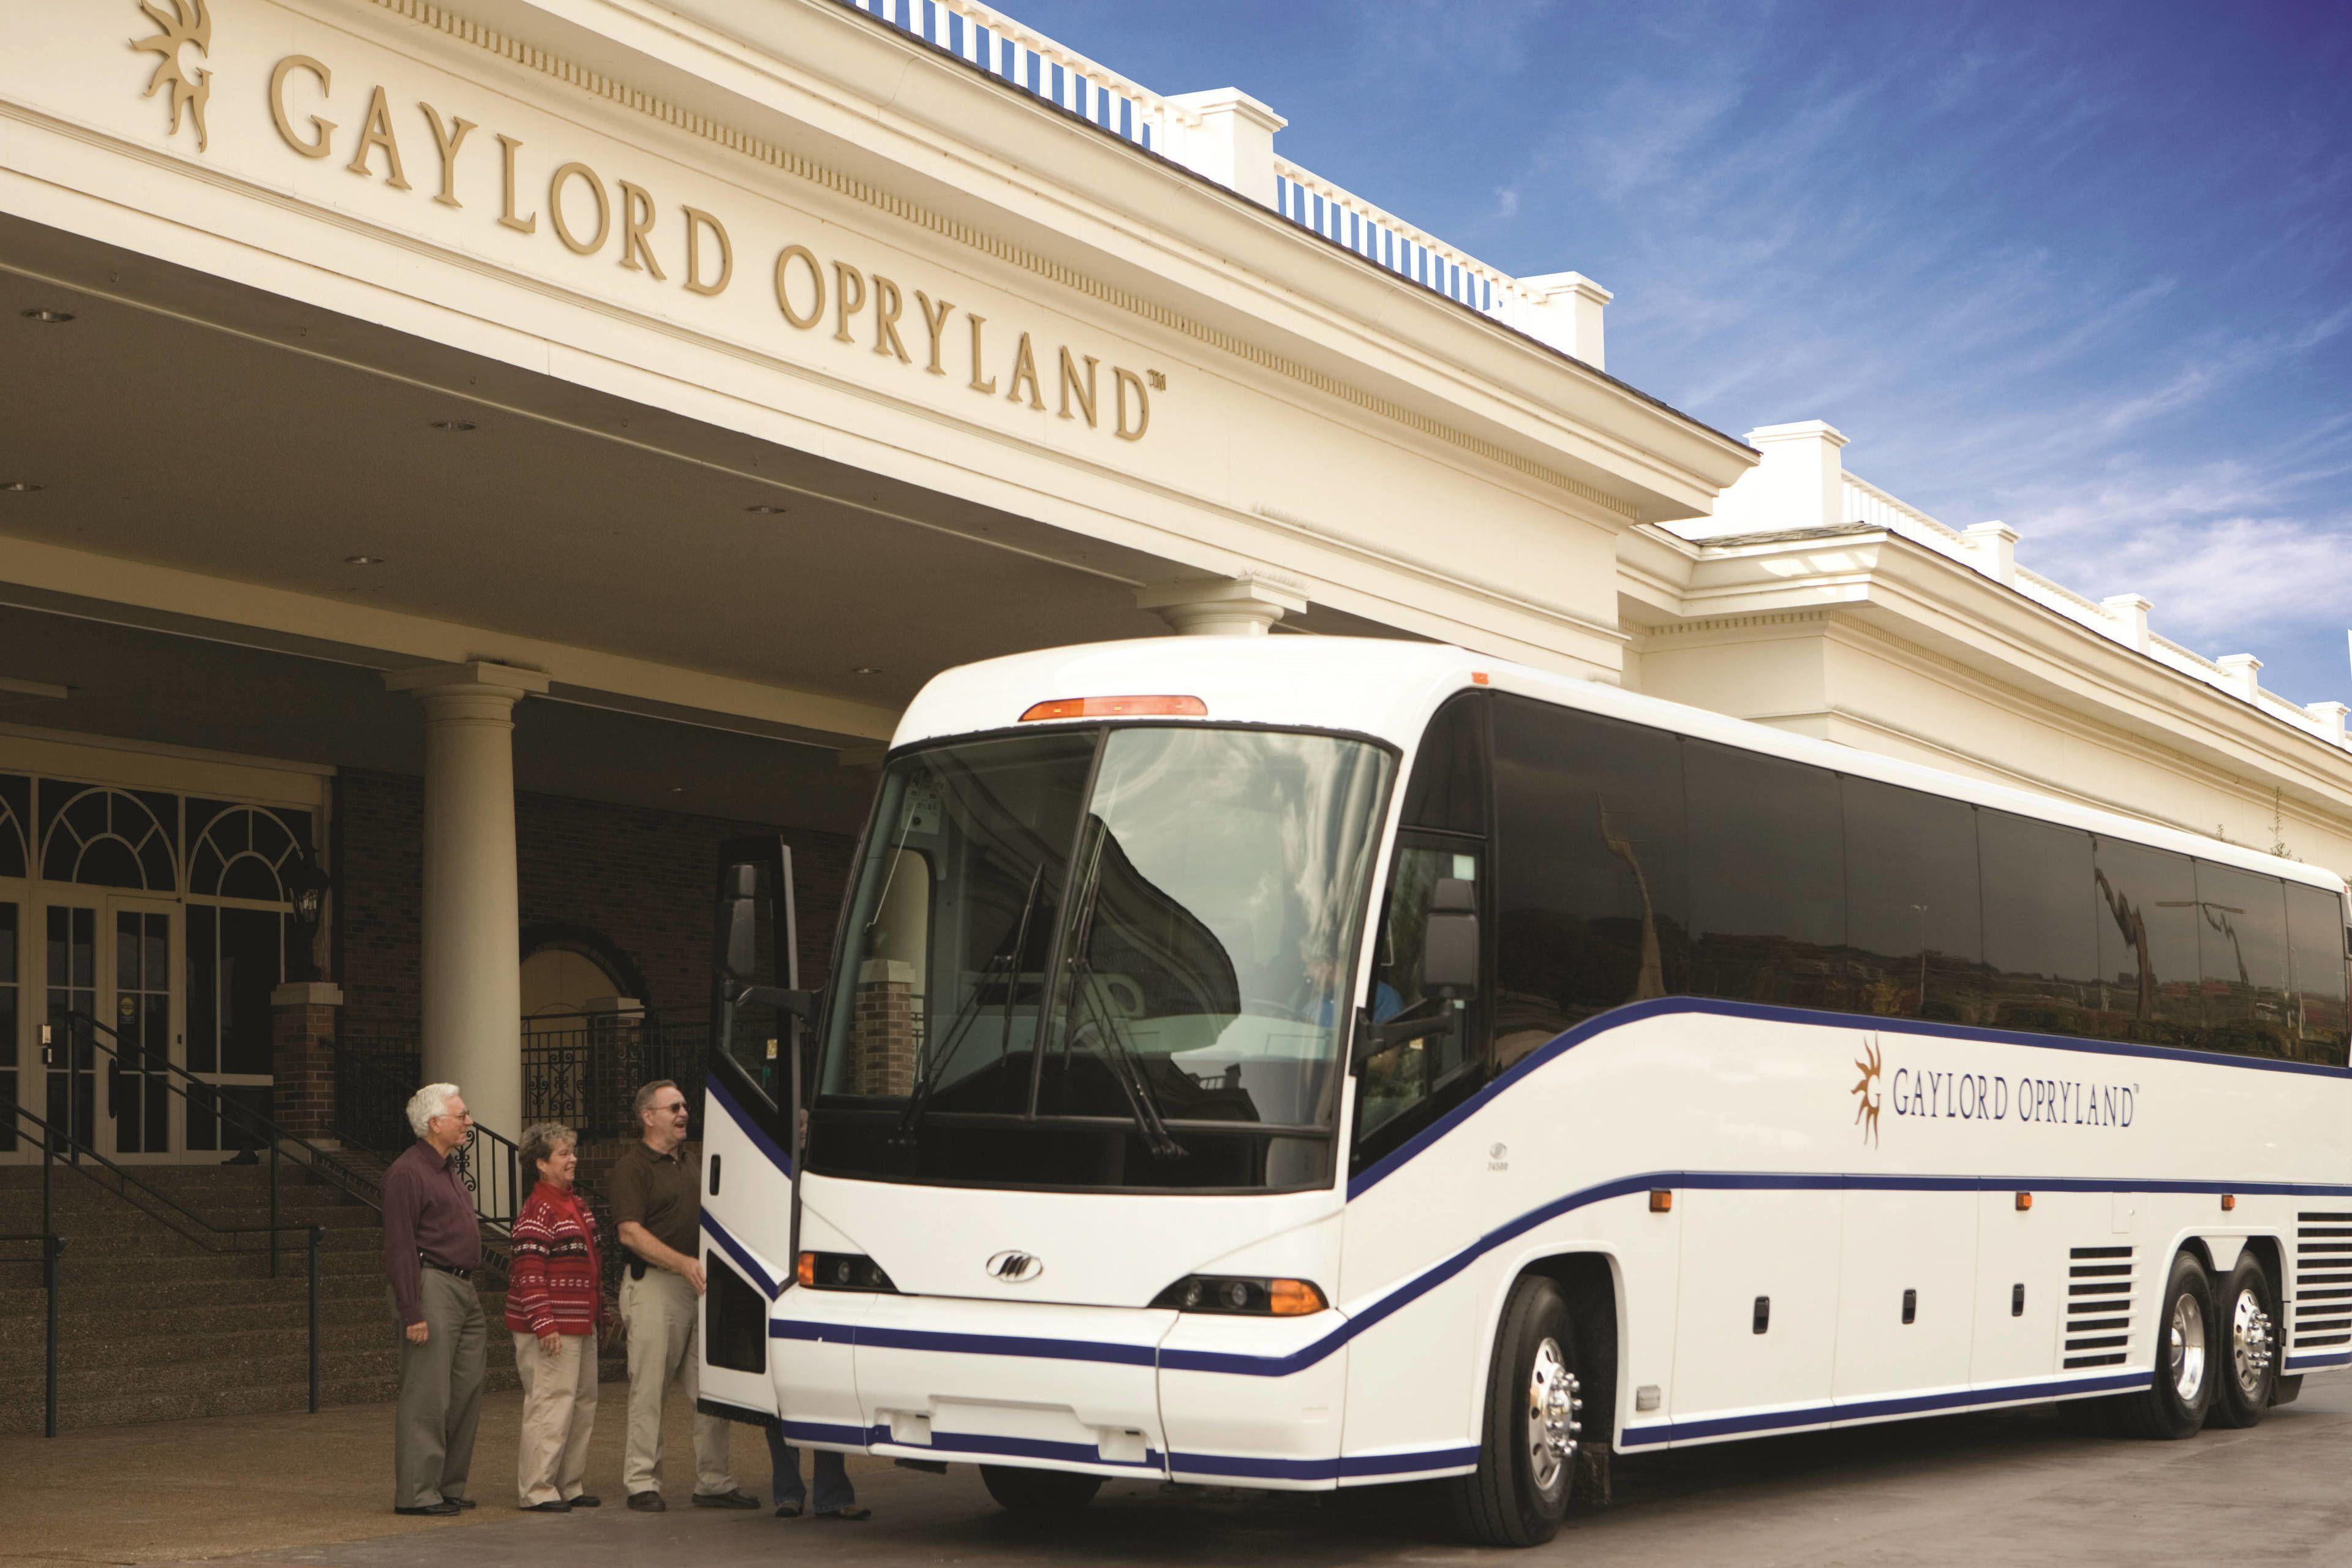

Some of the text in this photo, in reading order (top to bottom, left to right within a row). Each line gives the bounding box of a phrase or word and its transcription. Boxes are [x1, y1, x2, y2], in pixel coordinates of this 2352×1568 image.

[270, 53, 734, 297] GAYLORD
[774, 244, 1150, 442] OPRYLAND
[1893, 1067, 2008, 1120] GAYLORD
[2018, 1077, 2133, 1128] OPRYLAND
